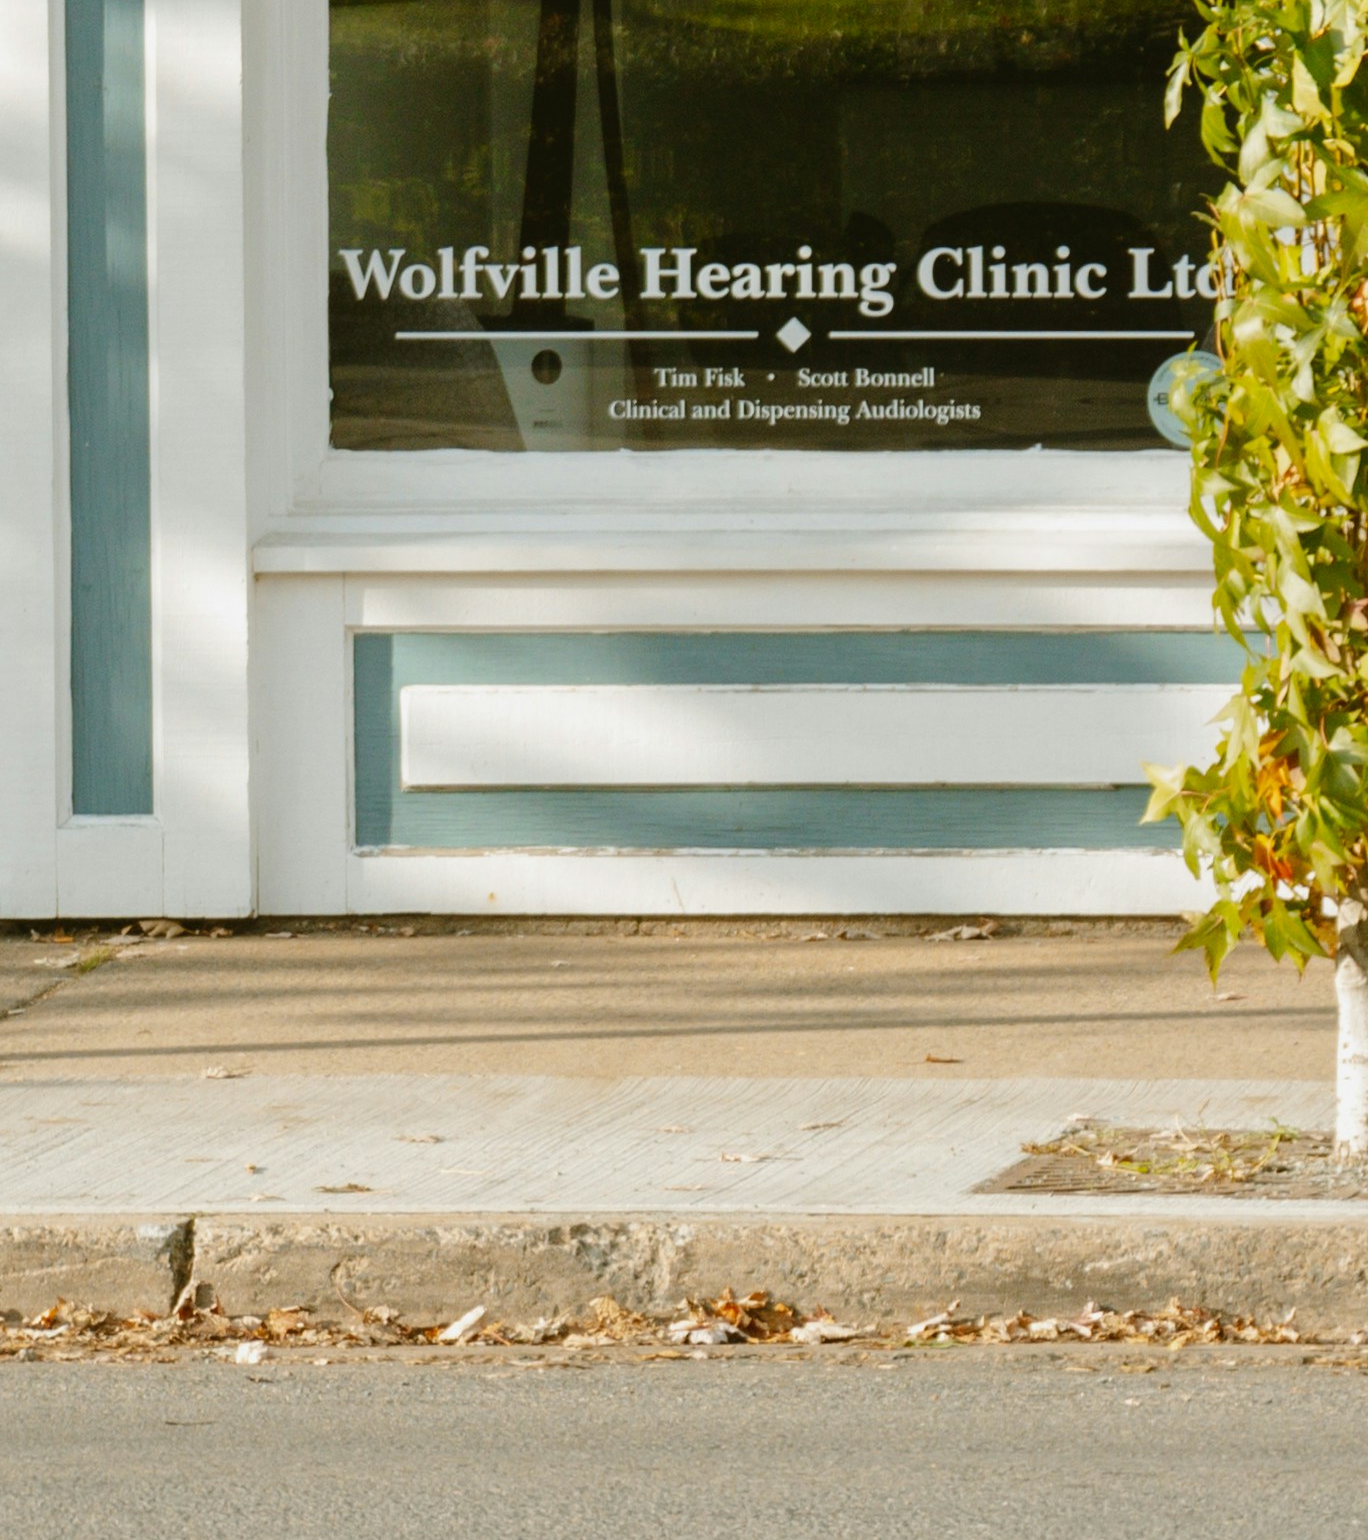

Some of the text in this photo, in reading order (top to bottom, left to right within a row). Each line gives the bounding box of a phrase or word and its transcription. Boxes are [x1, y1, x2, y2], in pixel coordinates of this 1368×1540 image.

[339, 246, 619, 299] Wolfville
[640, 246, 896, 319] Hearing
[918, 246, 1106, 298] Clinic
[654, 367, 934, 388] Tim Fisk Scott Bonnell
[608, 399, 981, 425] Clinical and Dispensing Audiologists
